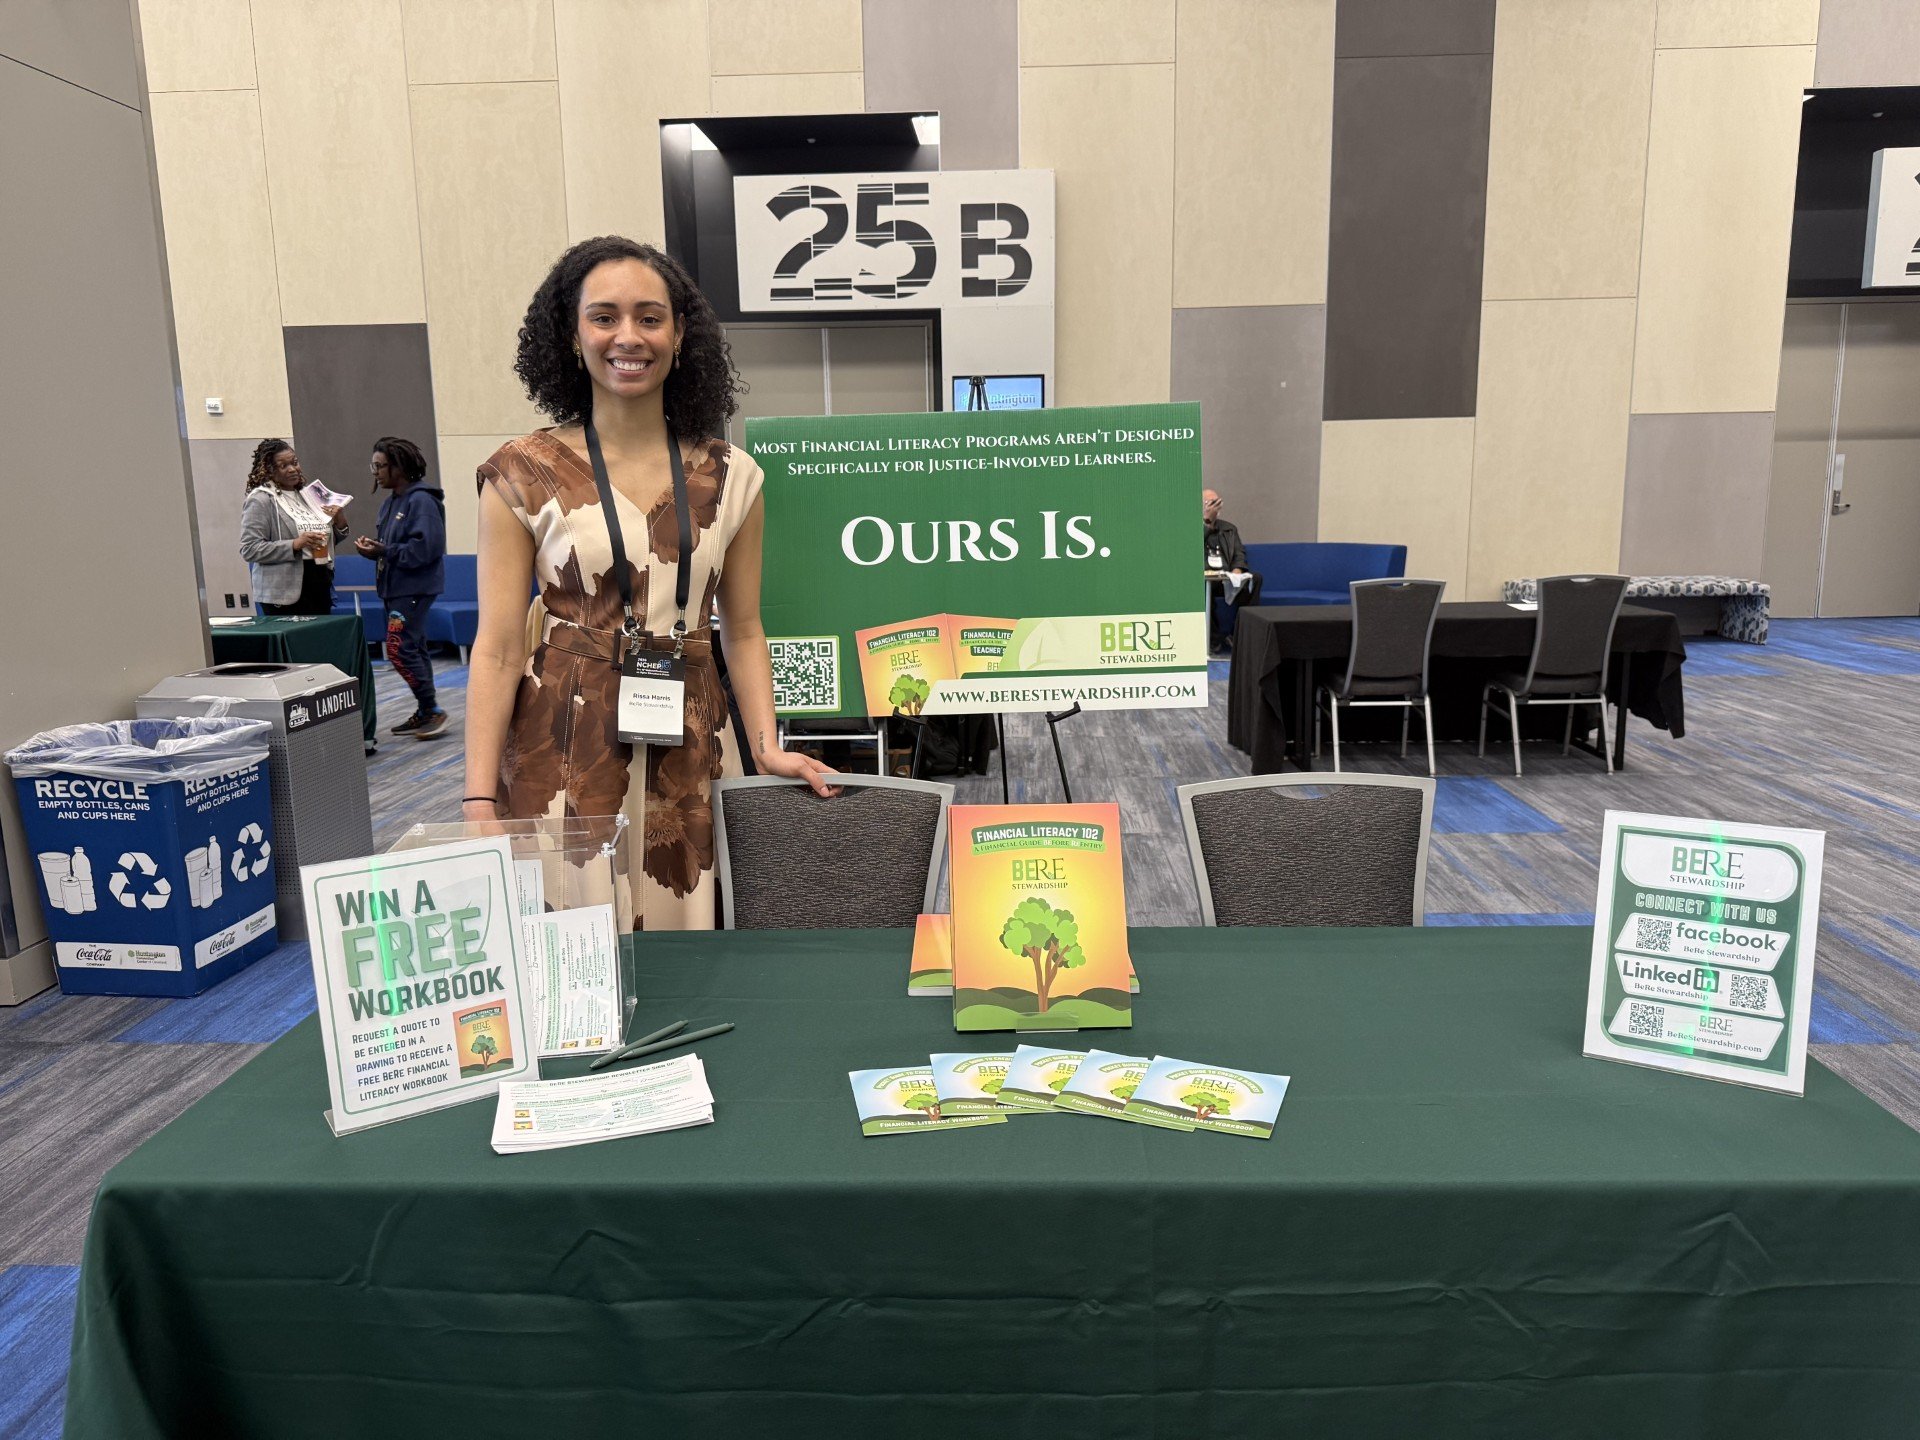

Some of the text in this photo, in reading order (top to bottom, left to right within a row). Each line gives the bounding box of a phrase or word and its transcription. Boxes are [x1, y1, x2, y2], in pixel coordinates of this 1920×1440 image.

[753, 427, 1195, 454] MOST FINANCIAL LITERACY PROGRAMS AREN'T DESIGNED
[788, 451, 1157, 476] SPECIFICALLY FOR JUSTICE-INVOLVED LEARNERS.
[840, 509, 1112, 566] OURS IS.
[869, 635, 897, 649] FINANCIAL
[897, 630, 925, 641] LITERACY
[926, 629, 937, 637] 102
[963, 631, 996, 639] FINANCIAL
[1100, 619, 1175, 652] BERE
[890, 650, 921, 667] BERE
[1100, 653, 1177, 664] STEWARDSHIP
[315, 689, 357, 718] LANDFILL
[632, 692, 650, 700] Rissa
[940, 685, 1197, 704] WWW.BERESTEWARDSHIP.COM
[34, 779, 150, 800] RECYCLE
[185, 791, 209, 807] EMPTY
[209, 780, 240, 798] BOTTLES,
[240, 773, 259, 786] CANS
[197, 786, 250, 814] AND CUPS HERE
[38, 800, 151, 811] EMPTY BOTTLES, CANS
[57, 811, 137, 821] AND CUPS HERE
[976, 825, 1099, 842] FINANCIAL LITERACY 102
[980, 841, 1018, 851] FINANCIAL
[1011, 857, 1067, 881] BERE
[1671, 846, 1746, 880] BERE
[1011, 882, 1068, 890] STEWARDSHIP
[1669, 874, 1745, 891] STEWARDSHIP
[335, 879, 437, 926] WIN A
[1635, 892, 1778, 925] CONNECT WITH US
[341, 906, 488, 988] FREE
[1676, 922, 1777, 951] facebook
[1683, 945, 1761, 964] BeRe Stewardship
[348, 965, 505, 1022] WORKBOOK
[1634, 982, 1709, 1001] BeRe Stewardship
[352, 1017, 441, 1044] REQUEST A QUOTE TO
[1698, 1027, 1734, 1038] STEWARDSHIP
[1699, 1014, 1734, 1033] BERE
[354, 1035, 426, 1059] BE ENTERED IN A
[1667, 1030, 1763, 1053] BeReStewardship.com
[356, 1043, 453, 1073] DRAWING TO RECEIVE A
[358, 1058, 451, 1087] FREE BERE FINANCIAL
[359, 1072, 449, 1101] LITERACY WORKBOOK
[1013, 1095, 1049, 1105] FINANCIAL
[1071, 1098, 1105, 1110] FINANCIAL
[917, 1118, 950, 1126] LITERACY
[952, 1115, 990, 1123] WORKBOOK
[1142, 1107, 1255, 1132] FINANCIAL LITERACY WORKBOOK
